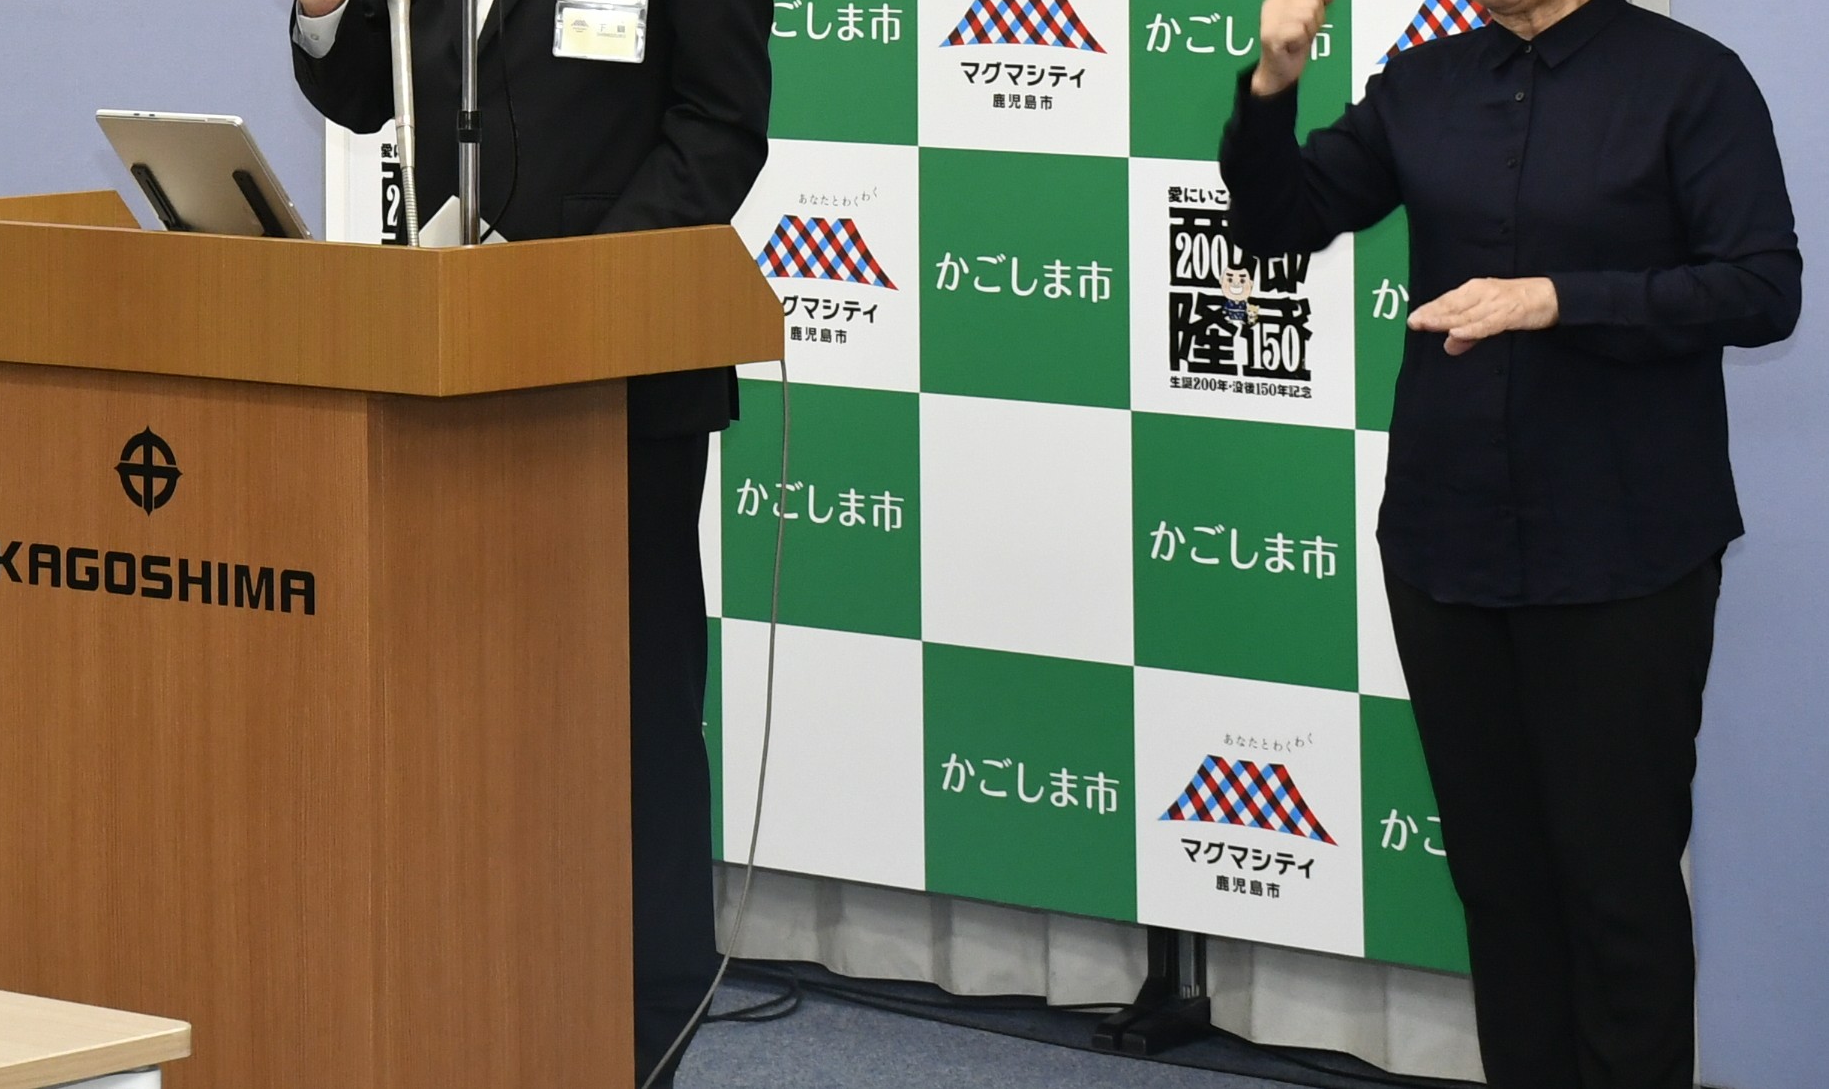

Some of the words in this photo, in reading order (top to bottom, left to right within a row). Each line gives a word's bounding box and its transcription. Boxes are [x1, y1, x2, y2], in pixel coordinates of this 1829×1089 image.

[1146, 13, 1333, 60] かごし
[961, 62, 1085, 88] マグマシティ
[993, 94, 1052, 110] 鹿児島市
[799, 187, 877, 206] あなたとわくわく
[1175, 232, 1228, 280] 200
[936, 253, 1112, 302] かごしま市
[783, 295, 878, 324] グマシティ
[791, 326, 846, 343] 鹿児島市
[1251, 322, 1301, 372] 150
[737, 479, 904, 531] かごしま市
[1151, 521, 1338, 579] かごしま市
[1224, 733, 1312, 752] あなたとわくわく
[942, 754, 1119, 814] かごしま市
[1181, 838, 1315, 880] マグマシティ
[1216, 875, 1281, 899] 鹿児島市
